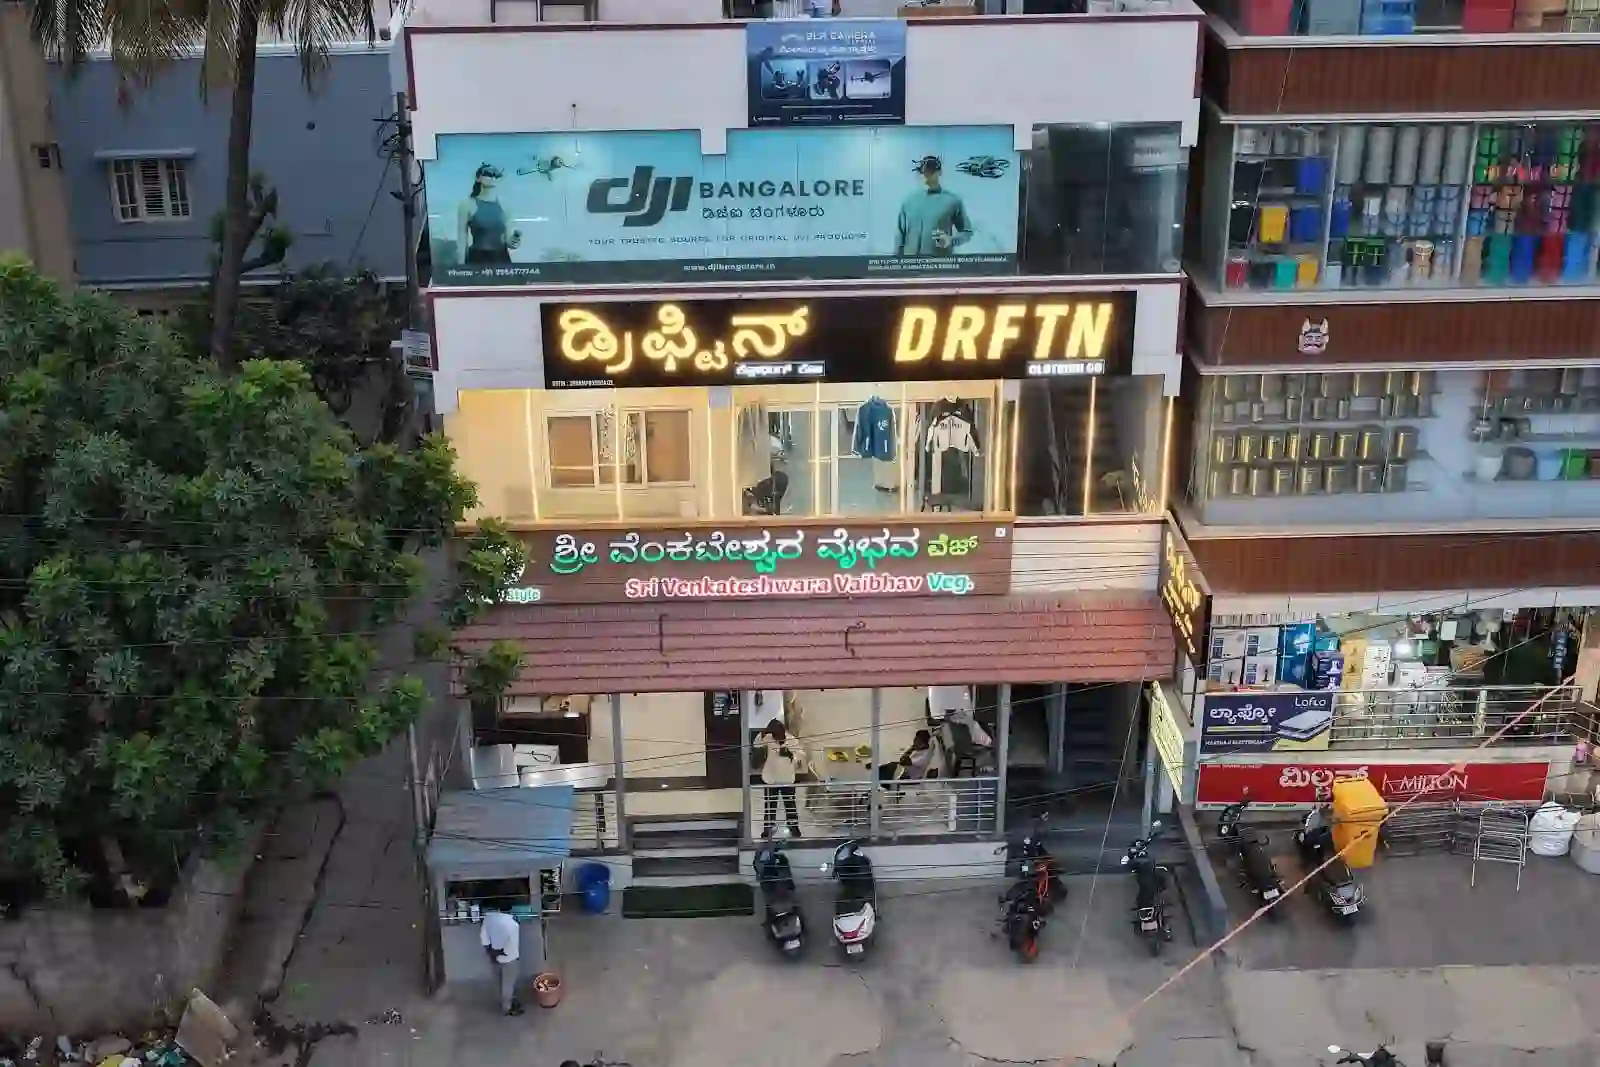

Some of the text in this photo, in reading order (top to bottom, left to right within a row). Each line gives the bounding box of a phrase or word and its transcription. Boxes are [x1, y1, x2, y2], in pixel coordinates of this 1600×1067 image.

[700, 179, 864, 199] BANGALORE
[894, 302, 1114, 363] DRFTN
[550, 533, 598, 574] ಶ್ರೀ
[609, 529, 804, 573] ವೆಂಕಟೇಶ್ವರ
[816, 527, 921, 569] ವೈಭವ
[624, 571, 976, 598] Sri Venkateshwara Vaibhav Veg.
[1399, 773, 1469, 791] MILTON
